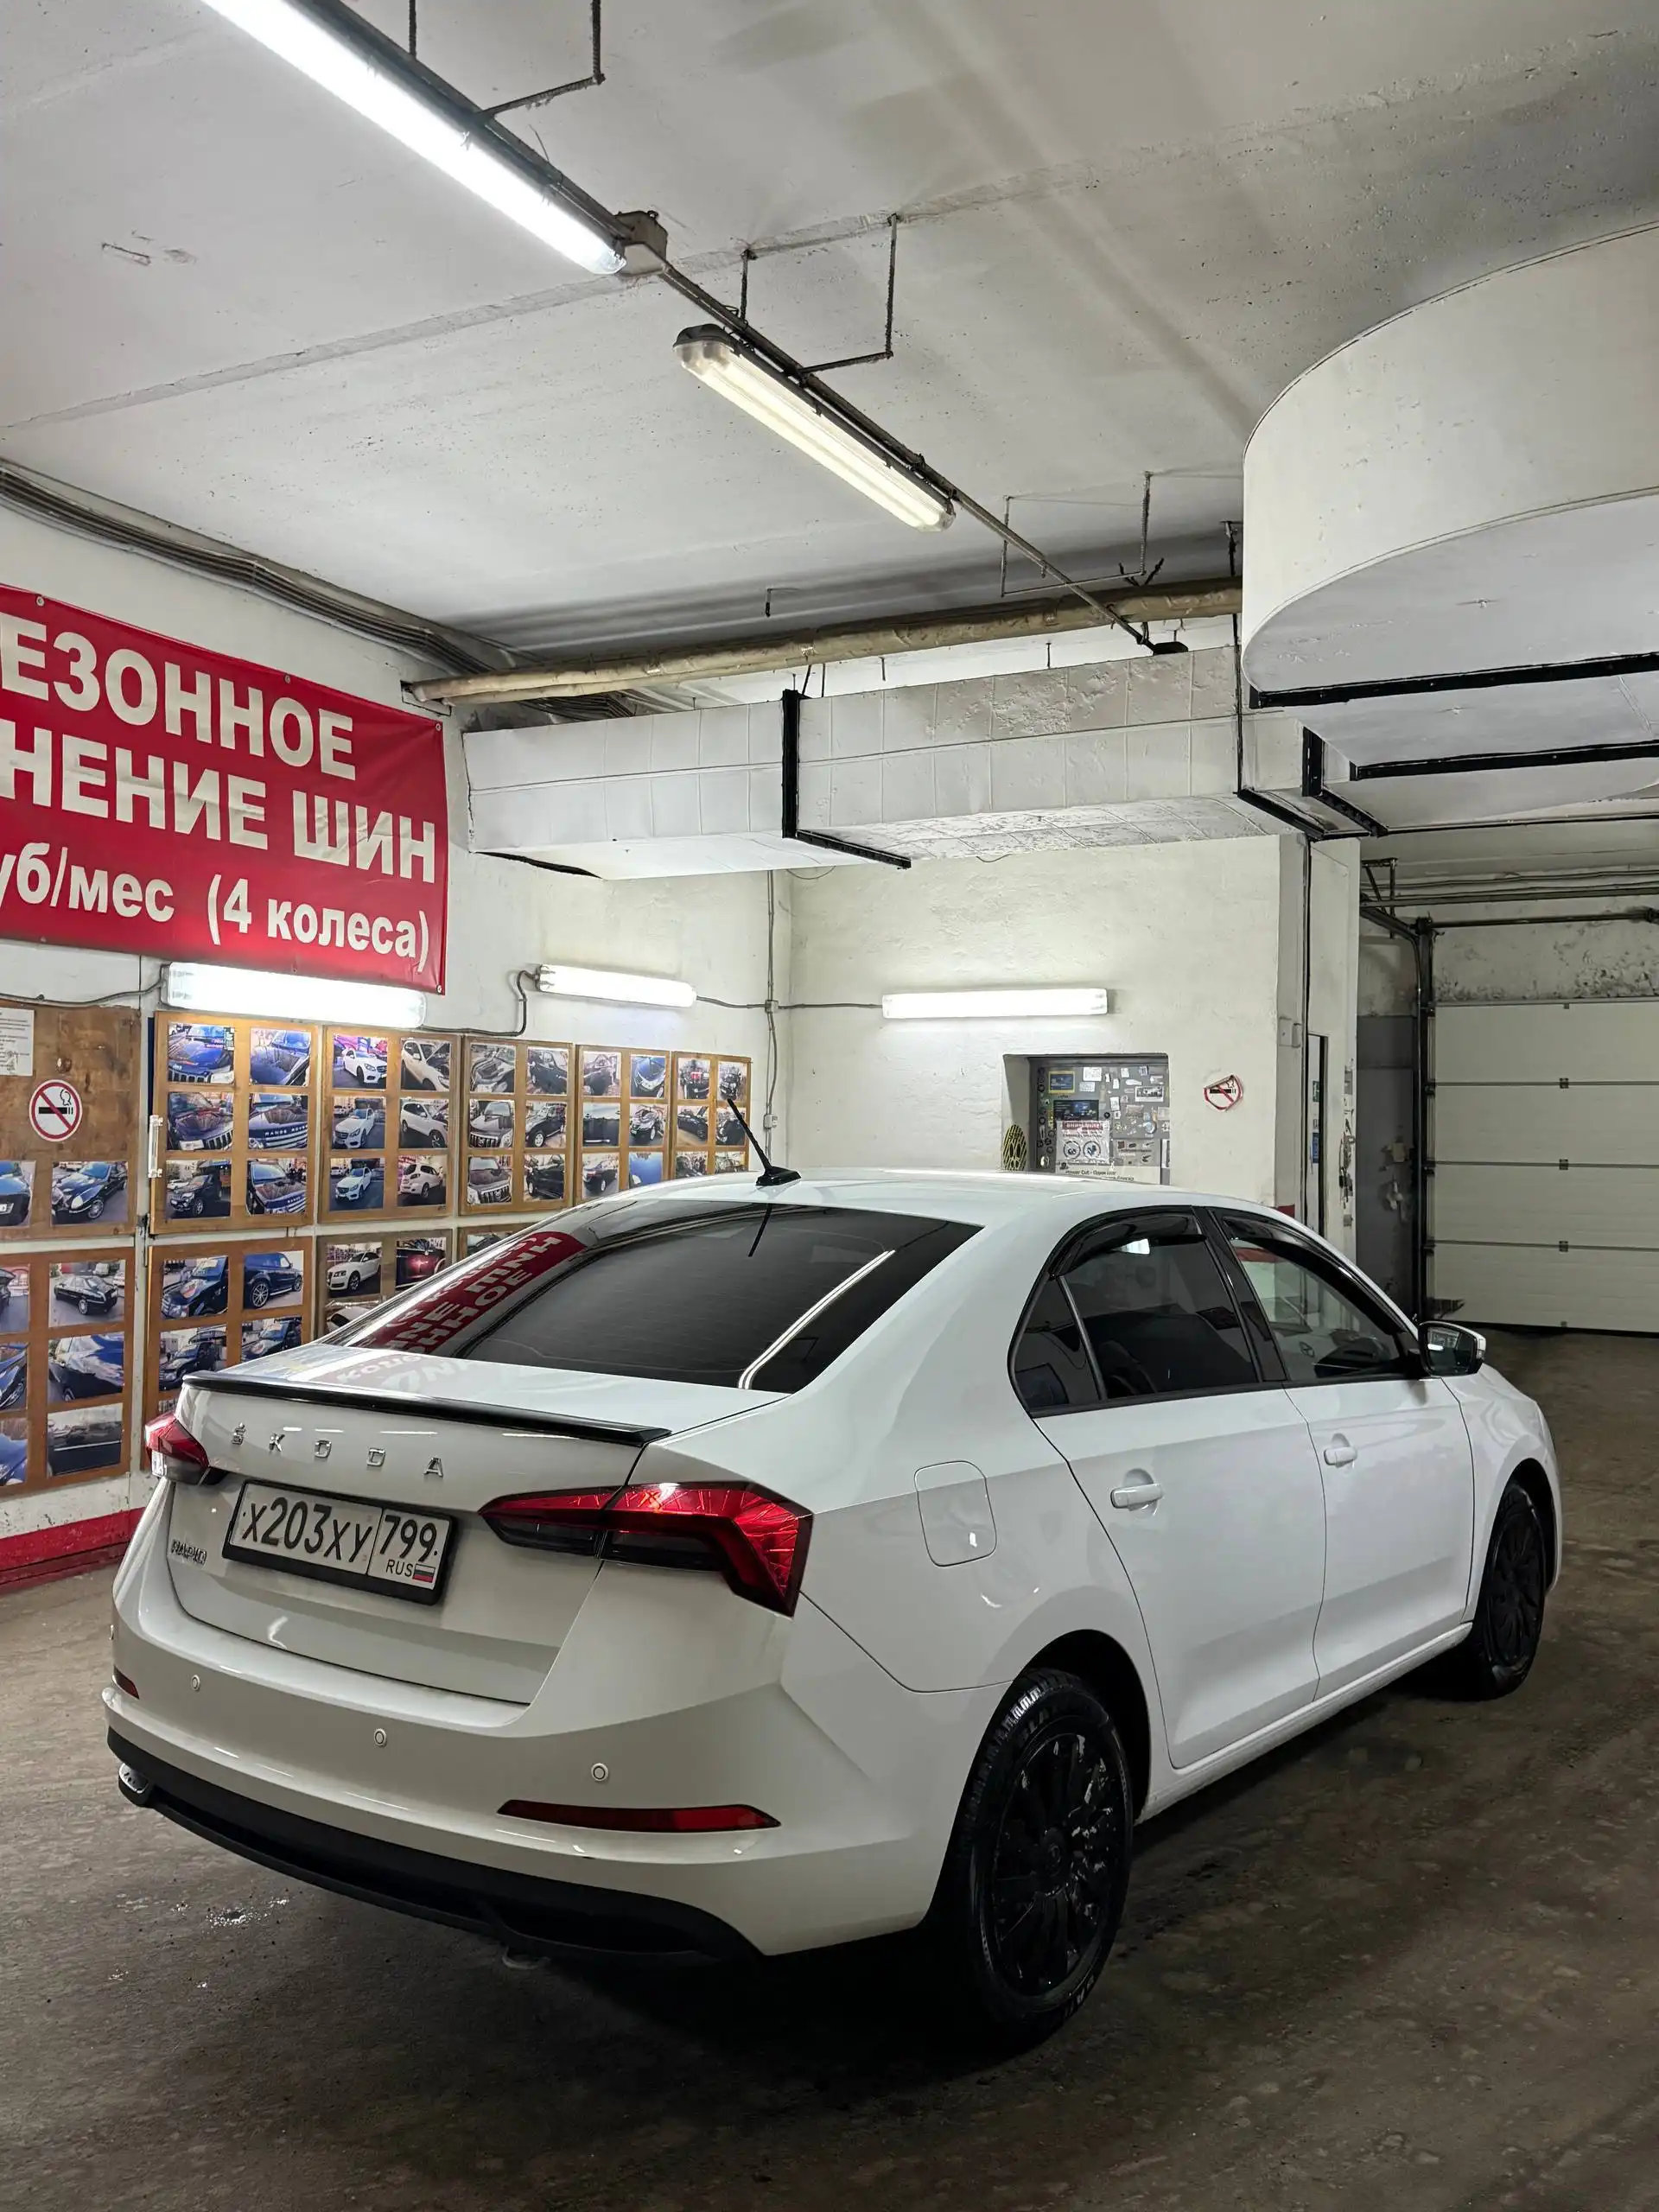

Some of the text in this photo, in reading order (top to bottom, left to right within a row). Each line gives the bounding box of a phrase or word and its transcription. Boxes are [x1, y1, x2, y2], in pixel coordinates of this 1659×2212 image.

[0, 612, 356, 779] ЕЗОННОЕ
[293, 790, 435, 883] ШИН
[207, 874, 252, 945] (4
[267, 897, 429, 973] колеса)
[379, 1514, 437, 1562] 799
[385, 1559, 413, 1578] RUS
